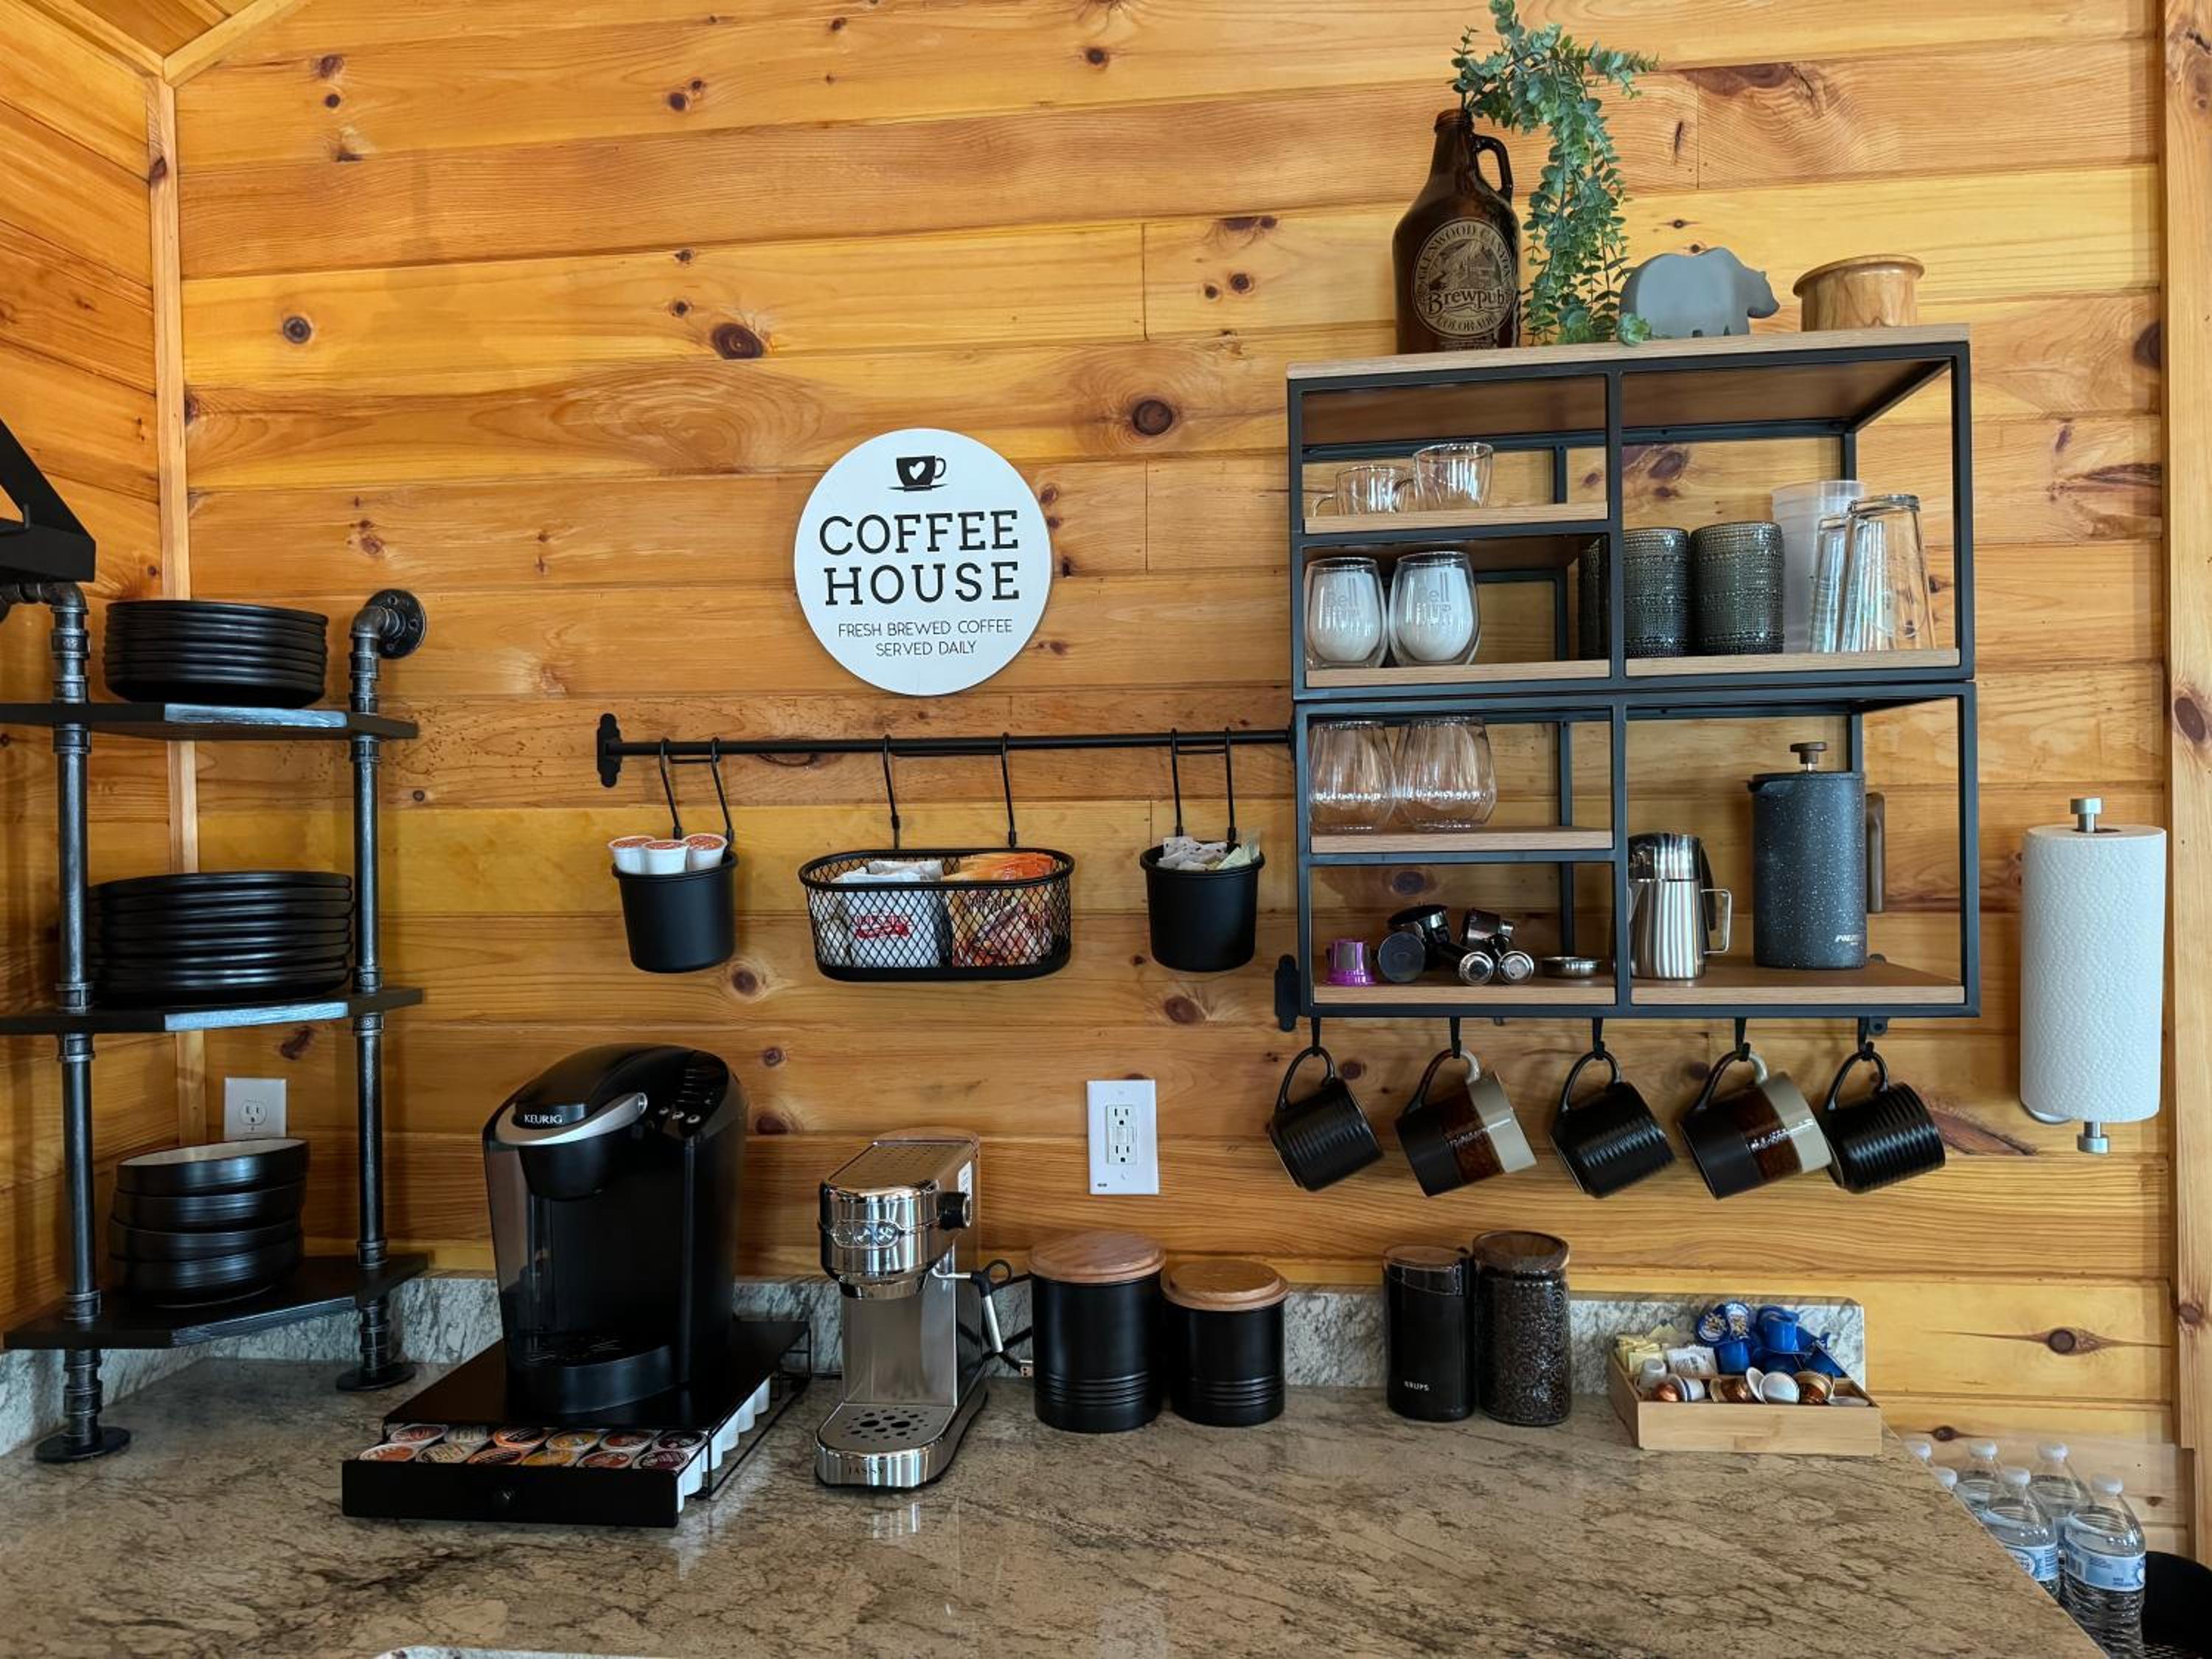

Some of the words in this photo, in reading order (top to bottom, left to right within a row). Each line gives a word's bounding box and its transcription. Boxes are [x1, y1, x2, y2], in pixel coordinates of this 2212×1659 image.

[1428, 288, 1505, 315] Brewpub
[819, 510, 1019, 555] COFFEE
[824, 561, 1020, 605] HOUSE
[838, 623, 882, 637] FRESH
[887, 621, 951, 636] BREWED
[958, 619, 1013, 633] COFFEE
[875, 642, 933, 656] SERVED
[939, 640, 977, 655] DAILY
[524, 1114, 563, 1124] KEURIG
[1403, 1380, 1430, 1391] KRUPS
